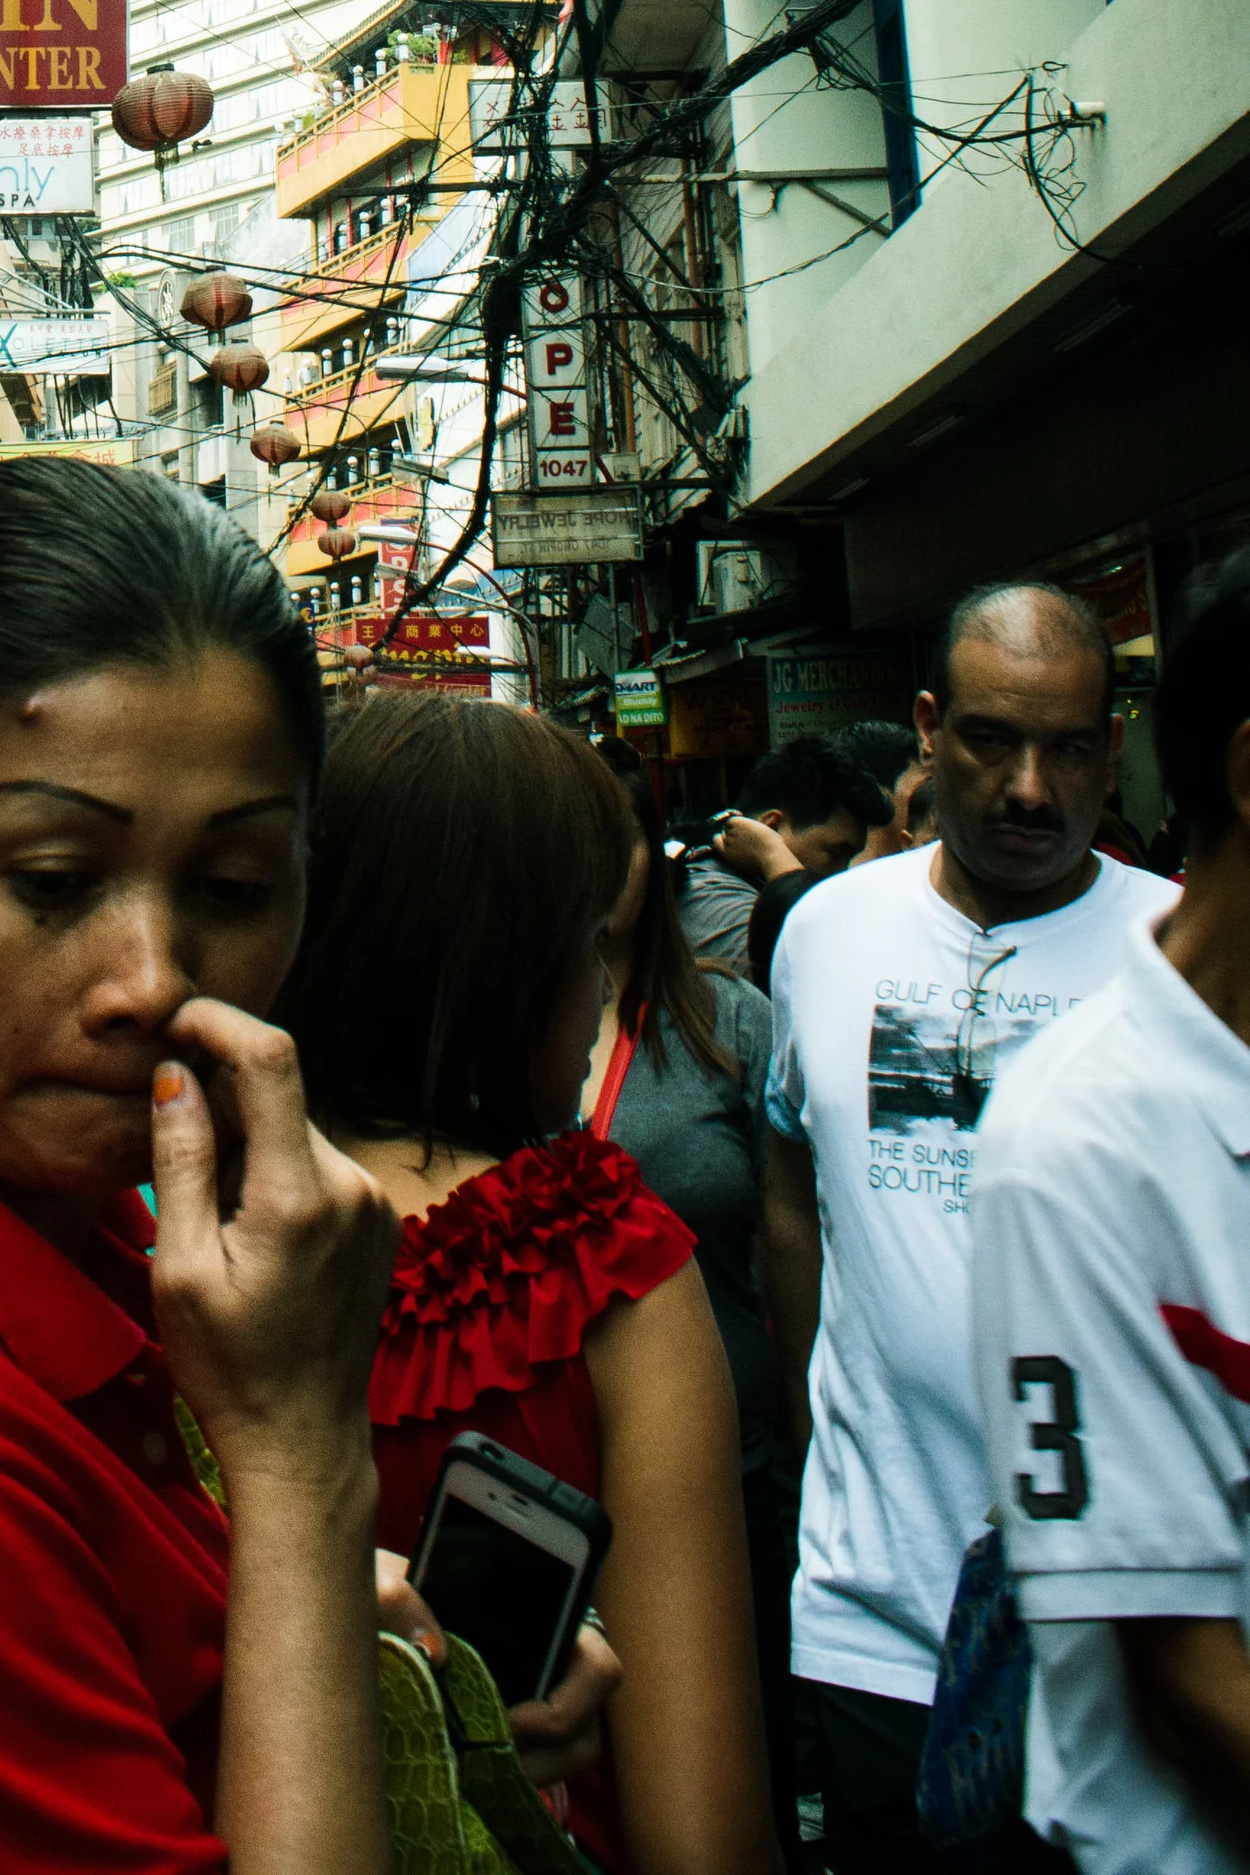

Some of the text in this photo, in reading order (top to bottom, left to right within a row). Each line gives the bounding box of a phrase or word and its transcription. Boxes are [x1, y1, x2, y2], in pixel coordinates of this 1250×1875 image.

[540, 459, 588, 477] 1047
[362, 624, 485, 639] 王商業中心
[615, 681, 657, 693] SMART
[774, 661, 794, 693] JG
[777, 700, 825, 715] Jewelry
[875, 979, 942, 1004] GULF
[951, 988, 987, 1011] OF
[868, 1138, 905, 1161] THE
[868, 1163, 971, 1198] SOUTHE
[1010, 1355, 1088, 1521] 3
